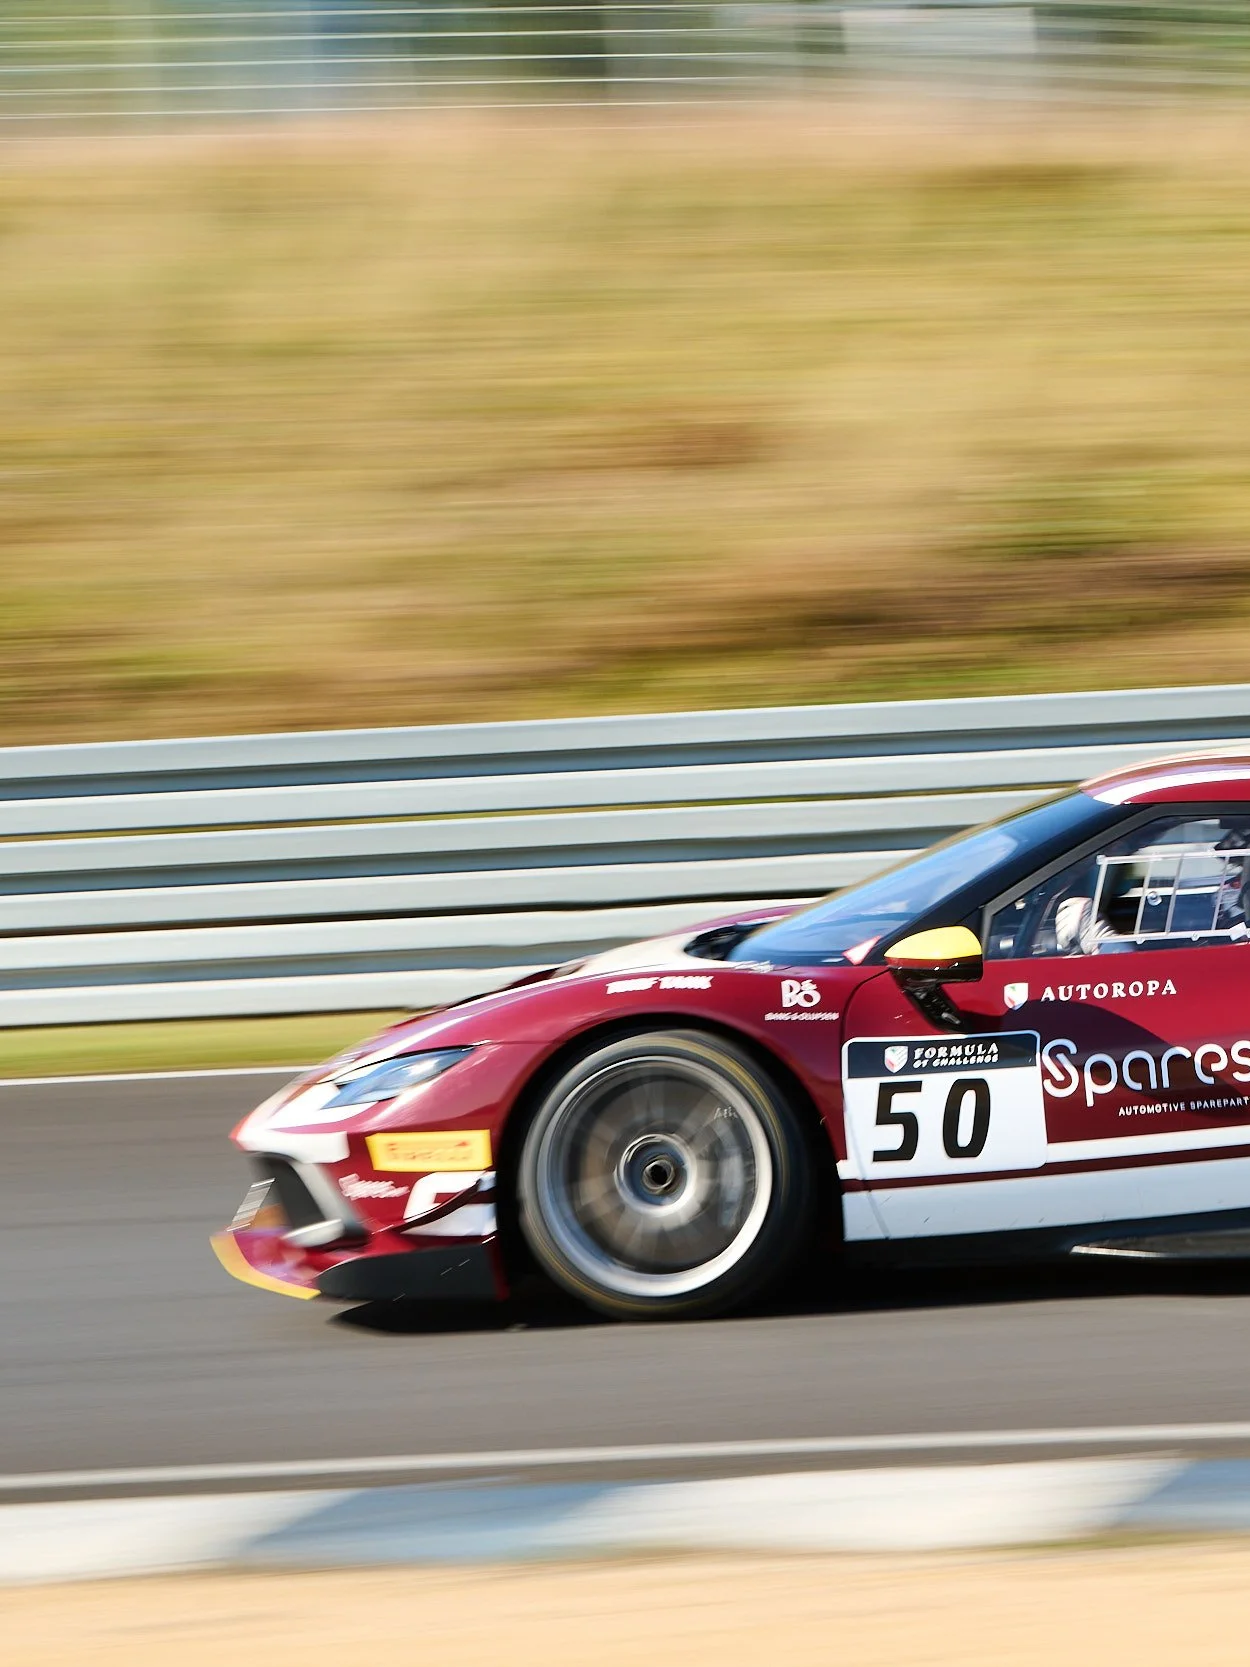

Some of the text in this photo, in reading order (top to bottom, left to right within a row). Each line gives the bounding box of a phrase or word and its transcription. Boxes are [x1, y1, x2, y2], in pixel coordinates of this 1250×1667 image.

[1041, 979, 1178, 1002] AUTOROPA
[914, 1043, 999, 1059] FORMULA
[932, 1054, 999, 1067] CHALLENGE
[1118, 1102, 1186, 1116] AUTOMOTIVE
[872, 1078, 991, 1162] 50
